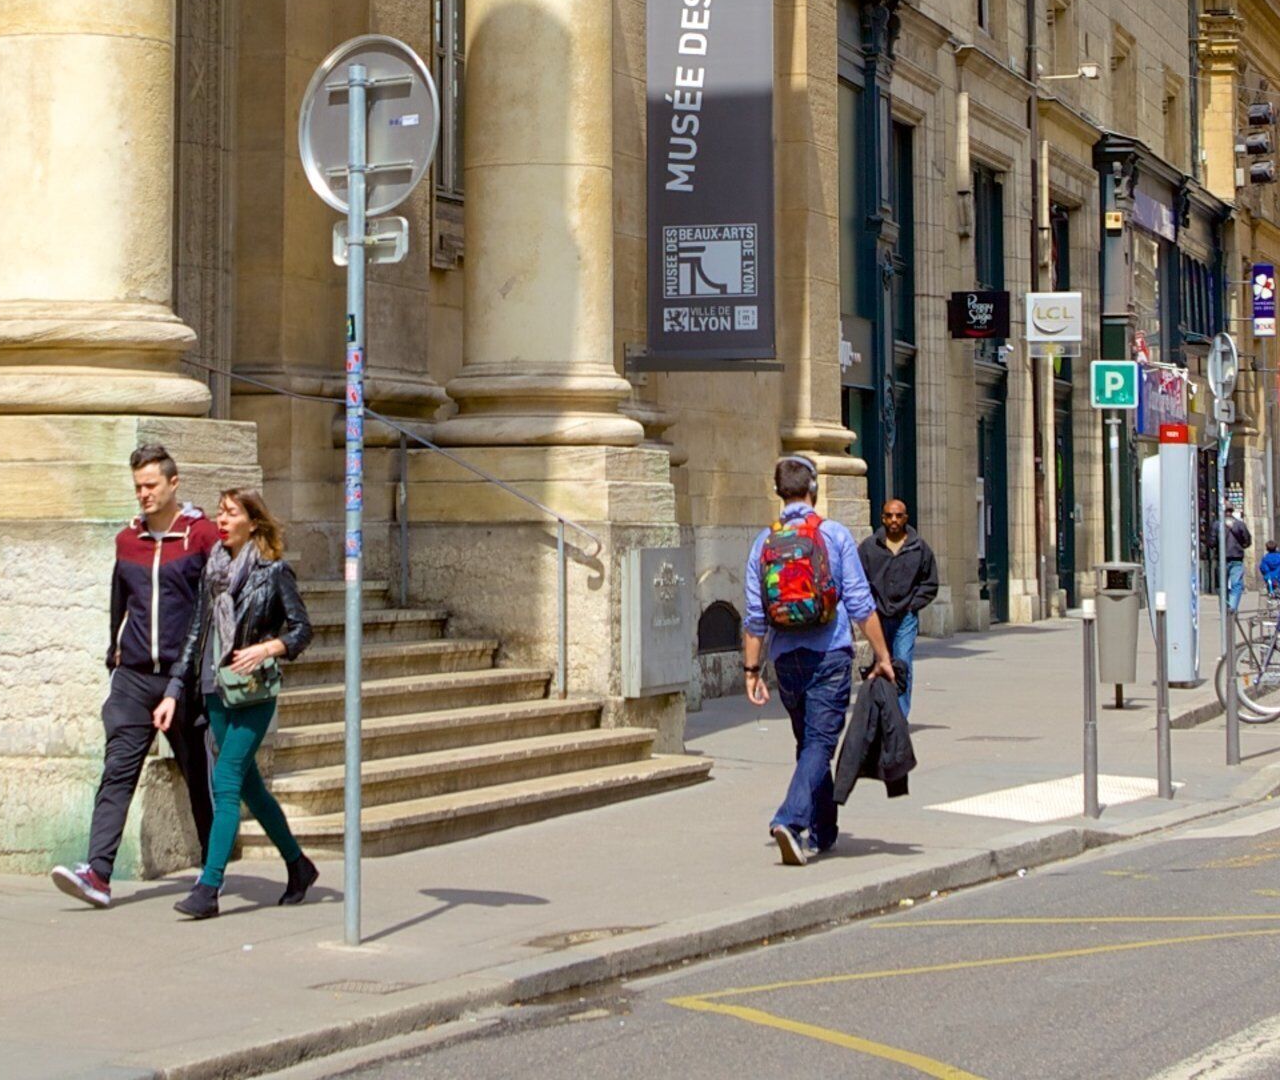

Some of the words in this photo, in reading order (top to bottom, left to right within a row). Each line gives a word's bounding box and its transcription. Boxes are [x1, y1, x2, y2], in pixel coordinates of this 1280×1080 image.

[664, 67, 704, 193] MUSÉE
[666, 229, 678, 252] DES
[679, 227, 754, 241] BEAUX-ARTS
[742, 240, 755, 257] DE
[666, 255, 678, 296] MUSEE
[742, 262, 755, 294] LYON
[690, 306, 716, 316] VILLE
[718, 305, 731, 315] DE
[967, 293, 994, 314] Peggy
[1036, 306, 1074, 320] LCL
[691, 316, 731, 332] LYON
[966, 310, 993, 325] Sage
[1105, 371, 1125, 399] P
